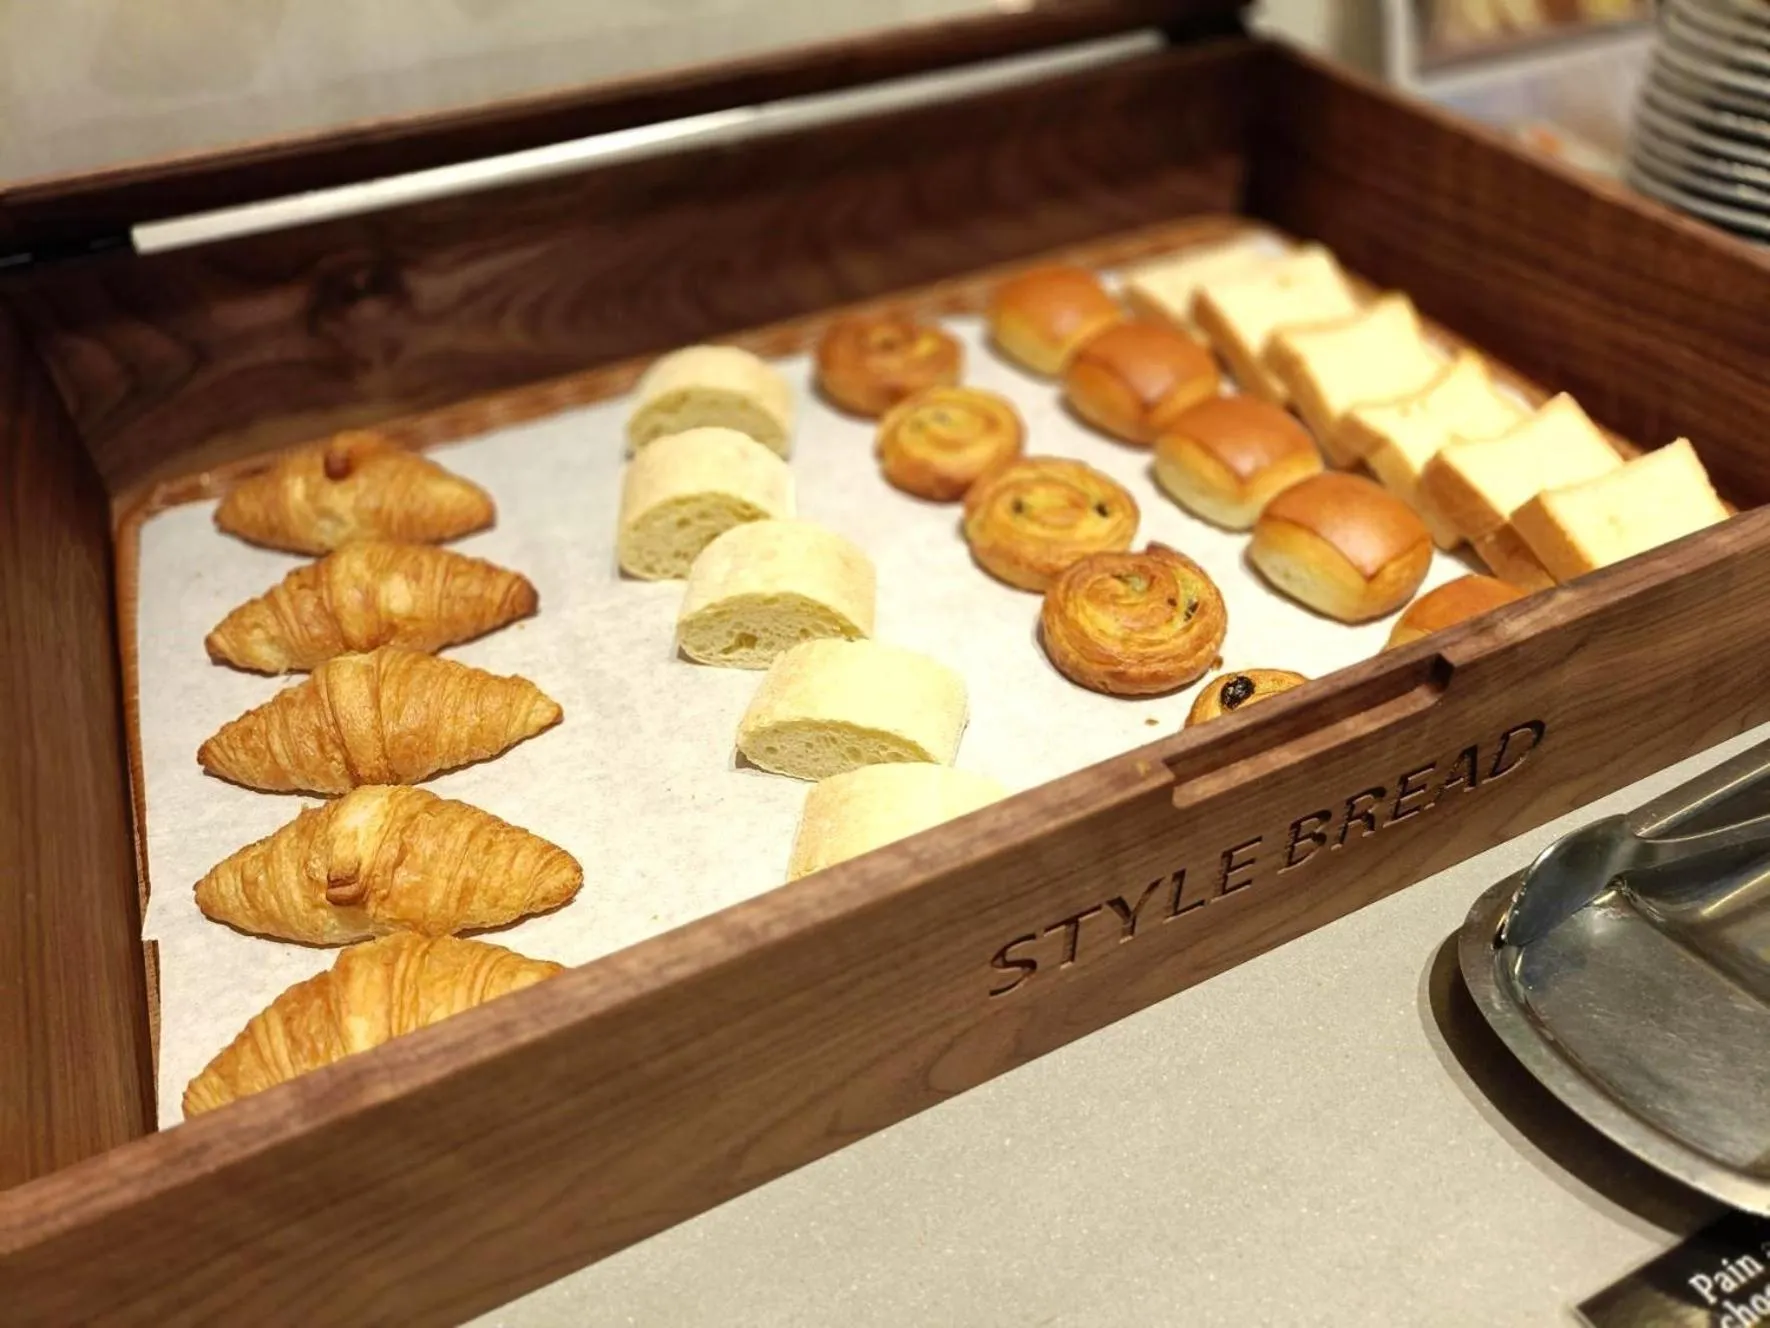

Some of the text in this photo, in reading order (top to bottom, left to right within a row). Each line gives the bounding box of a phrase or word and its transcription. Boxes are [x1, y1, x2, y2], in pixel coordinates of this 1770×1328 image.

[989, 719, 1546, 998] STYLE BREAD
[1688, 1254, 1764, 1304] Pain
